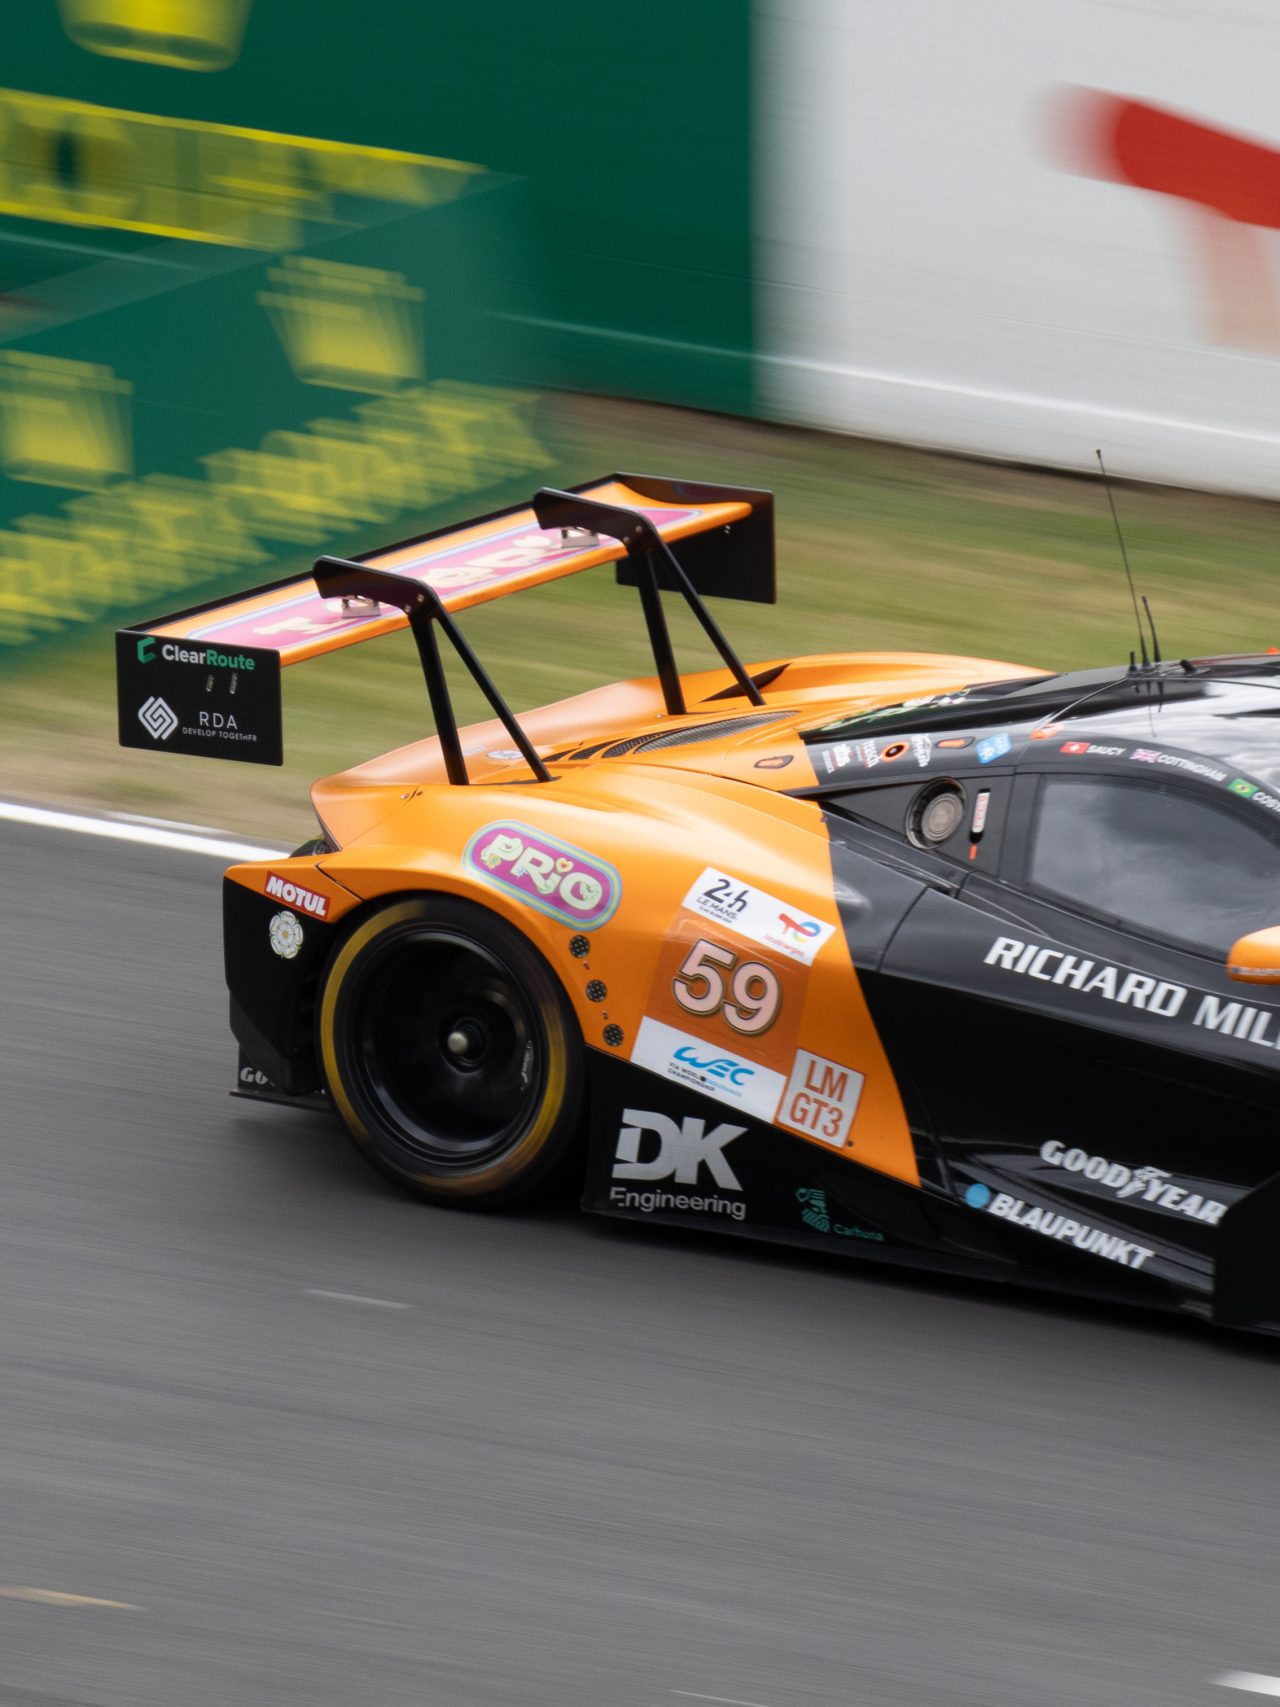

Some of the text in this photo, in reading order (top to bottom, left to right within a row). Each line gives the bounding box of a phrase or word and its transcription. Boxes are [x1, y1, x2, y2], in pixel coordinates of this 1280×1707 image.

[161, 643, 256, 671] ClearRoute
[182, 727, 257, 742] DEVELOP TOGETHER
[199, 711, 238, 730] RDA
[1086, 744, 1126, 756] SAUCY
[1157, 754, 1227, 782] COTTINGHAM
[265, 875, 327, 917] MOTUL
[697, 897, 708, 906] LE
[709, 902, 737, 919] MANS
[672, 937, 783, 1037] 59
[983, 936, 1188, 1018] RICHARD
[673, 1046, 755, 1086] WEC
[804, 1058, 849, 1103] LM
[789, 1092, 844, 1138] GT3
[612, 1108, 749, 1191] DK
[610, 1187, 746, 1220] Engineering
[1040, 1139, 1229, 1228] GOODYEAR
[988, 1193, 1155, 1270] BLAUPUNKT
